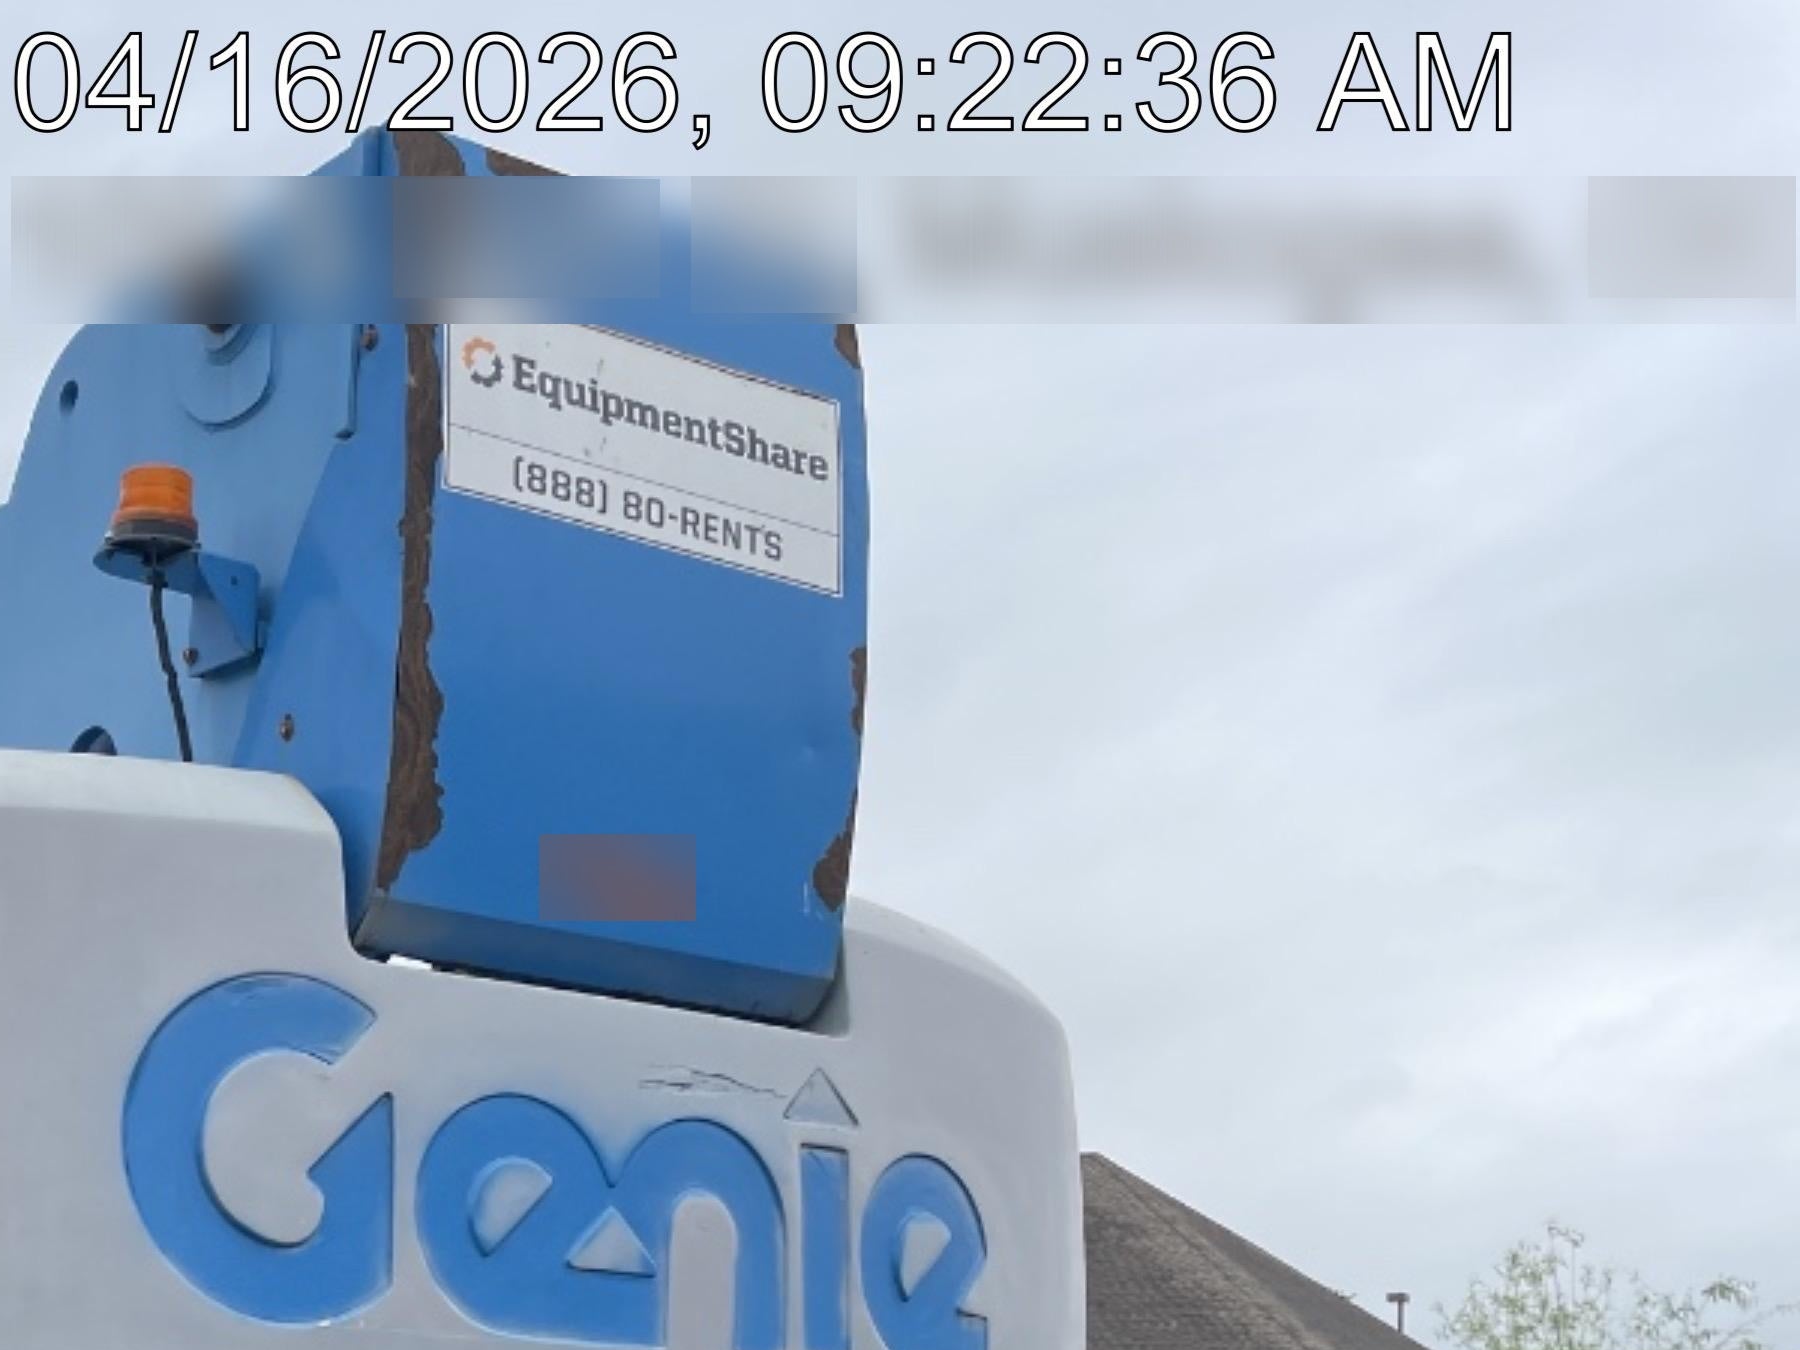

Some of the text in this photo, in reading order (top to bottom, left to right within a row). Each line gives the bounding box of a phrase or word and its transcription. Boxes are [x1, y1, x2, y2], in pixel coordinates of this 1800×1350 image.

[512, 354, 829, 481] EquipmentShare
[512, 455, 782, 562] (888) 80-RENTS
